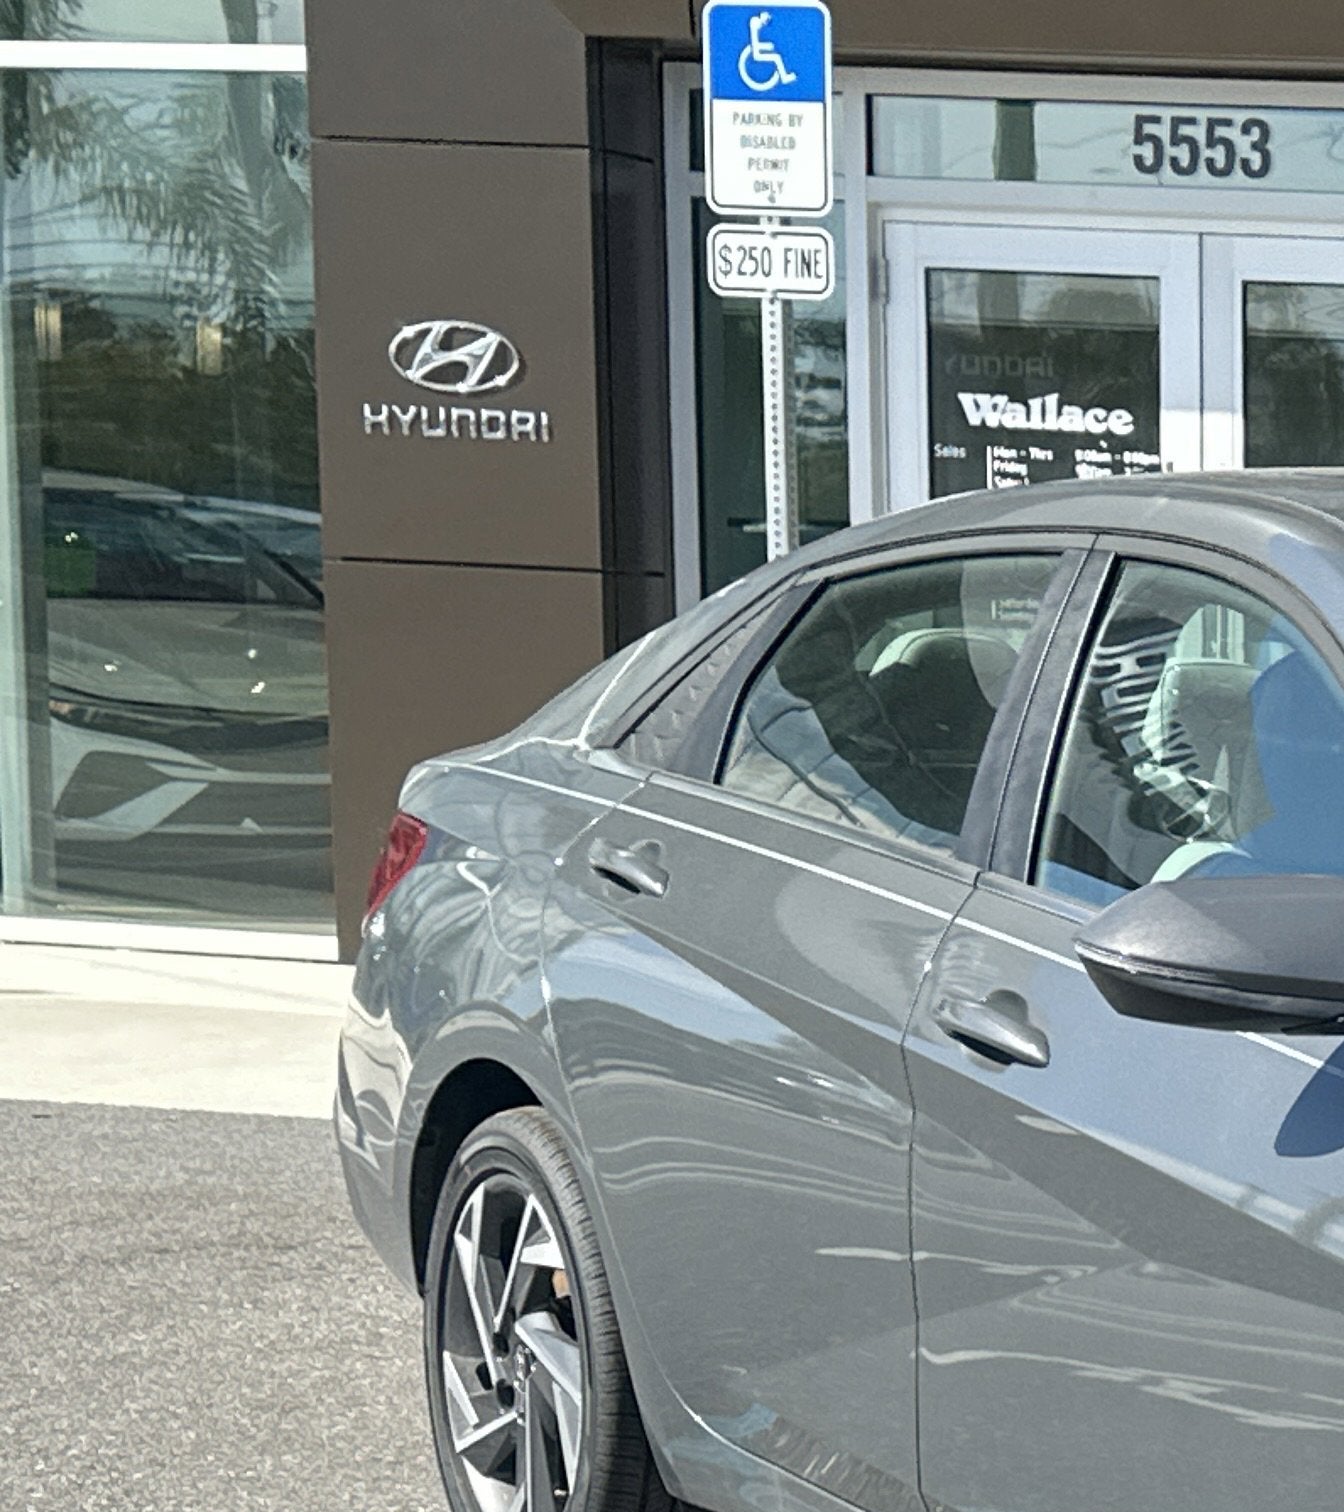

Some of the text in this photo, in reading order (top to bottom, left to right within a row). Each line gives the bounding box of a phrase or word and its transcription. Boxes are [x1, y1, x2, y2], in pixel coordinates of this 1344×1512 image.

[732, 112, 804, 128] PARKING BY
[740, 135, 796, 150] DISABLED
[1132, 114, 1271, 178] 5553
[747, 157, 790, 172] PERMIT
[753, 180, 784, 194] ONLY
[718, 244, 823, 279] $250 FINE
[363, 402, 550, 443] HYUNDAI
[957, 391, 1135, 435] Wallace
